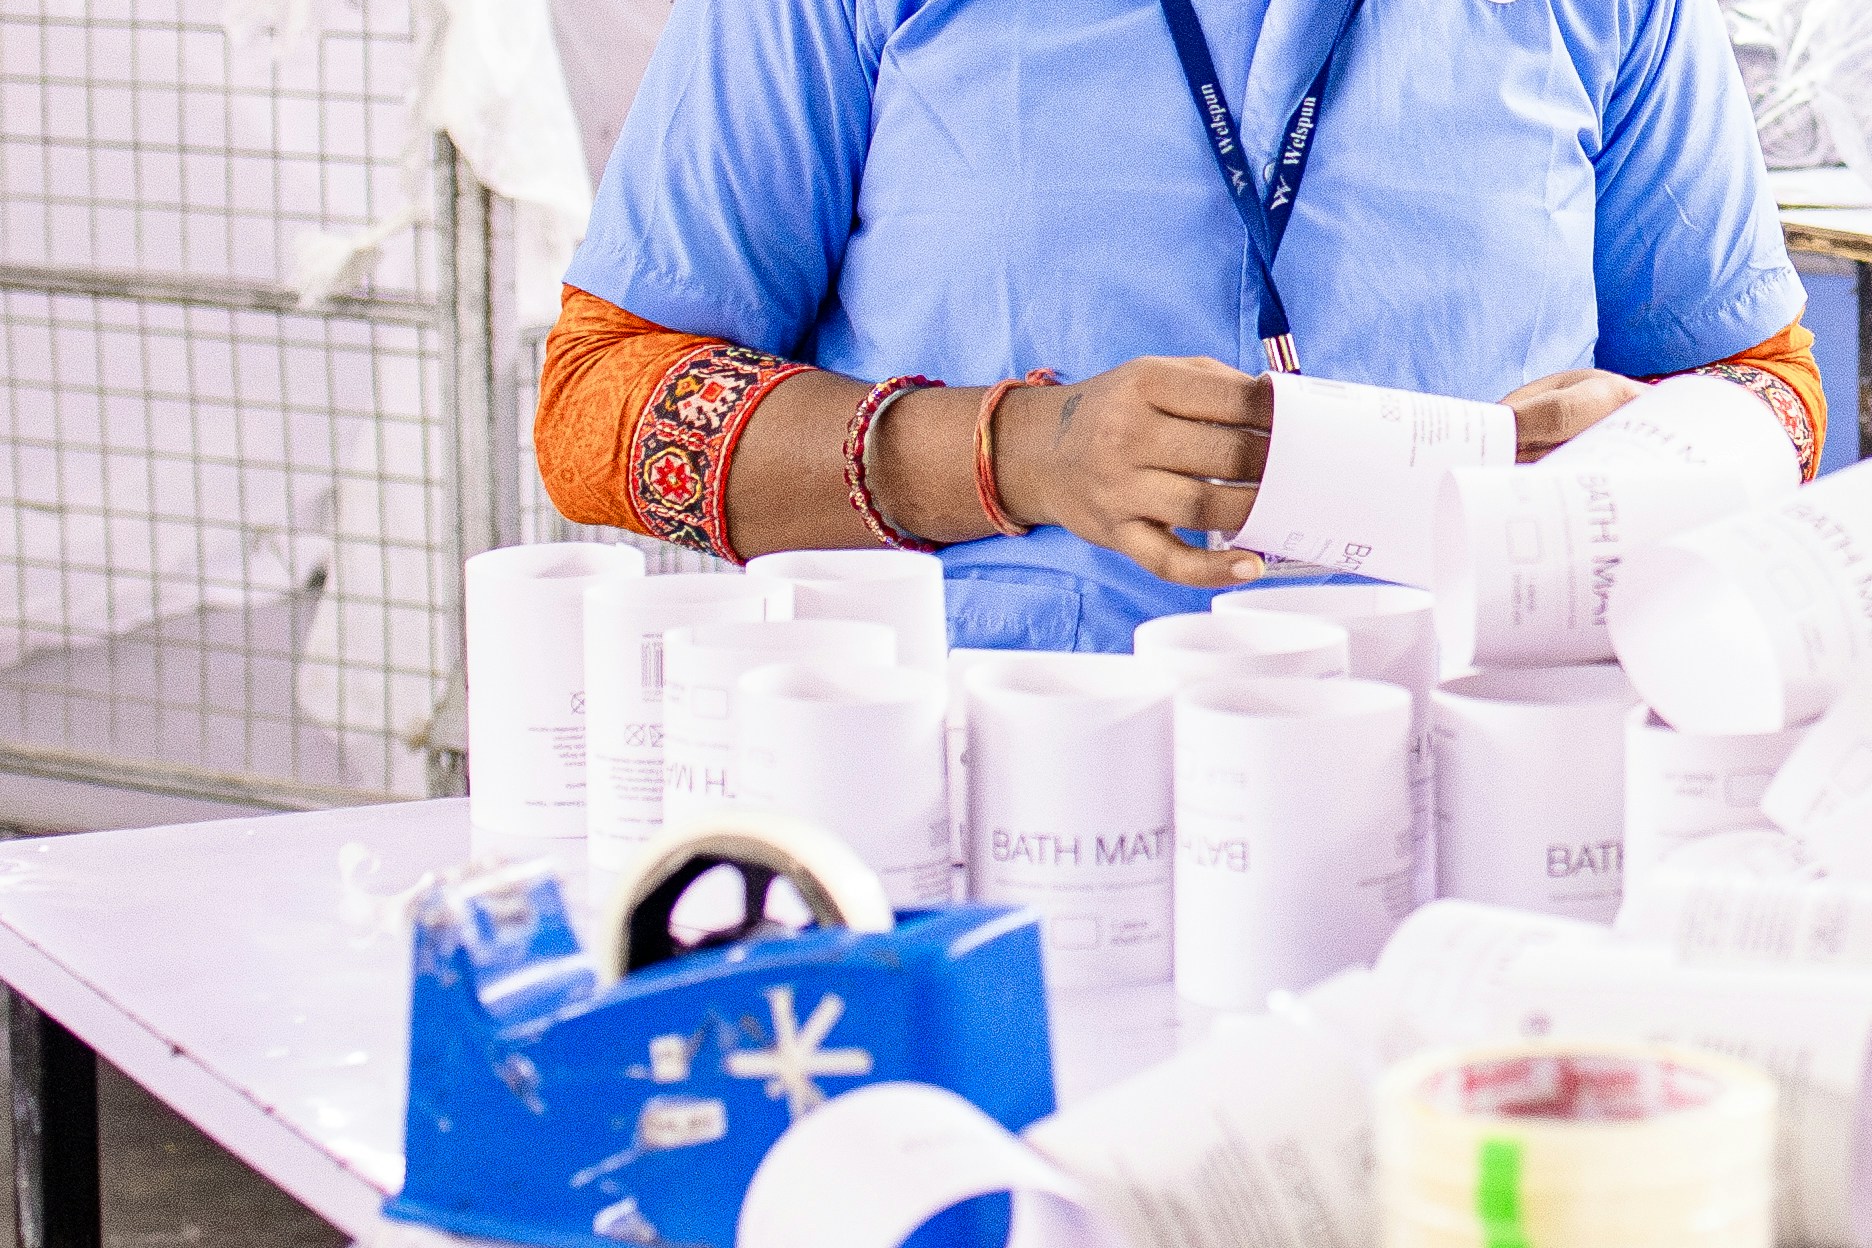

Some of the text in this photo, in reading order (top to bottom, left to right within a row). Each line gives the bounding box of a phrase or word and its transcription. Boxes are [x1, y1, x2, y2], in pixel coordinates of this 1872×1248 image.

[1201, 83, 1236, 156] Welspun
[1282, 96, 1318, 166] Welspun
[990, 823, 1169, 867] BATH MAT
